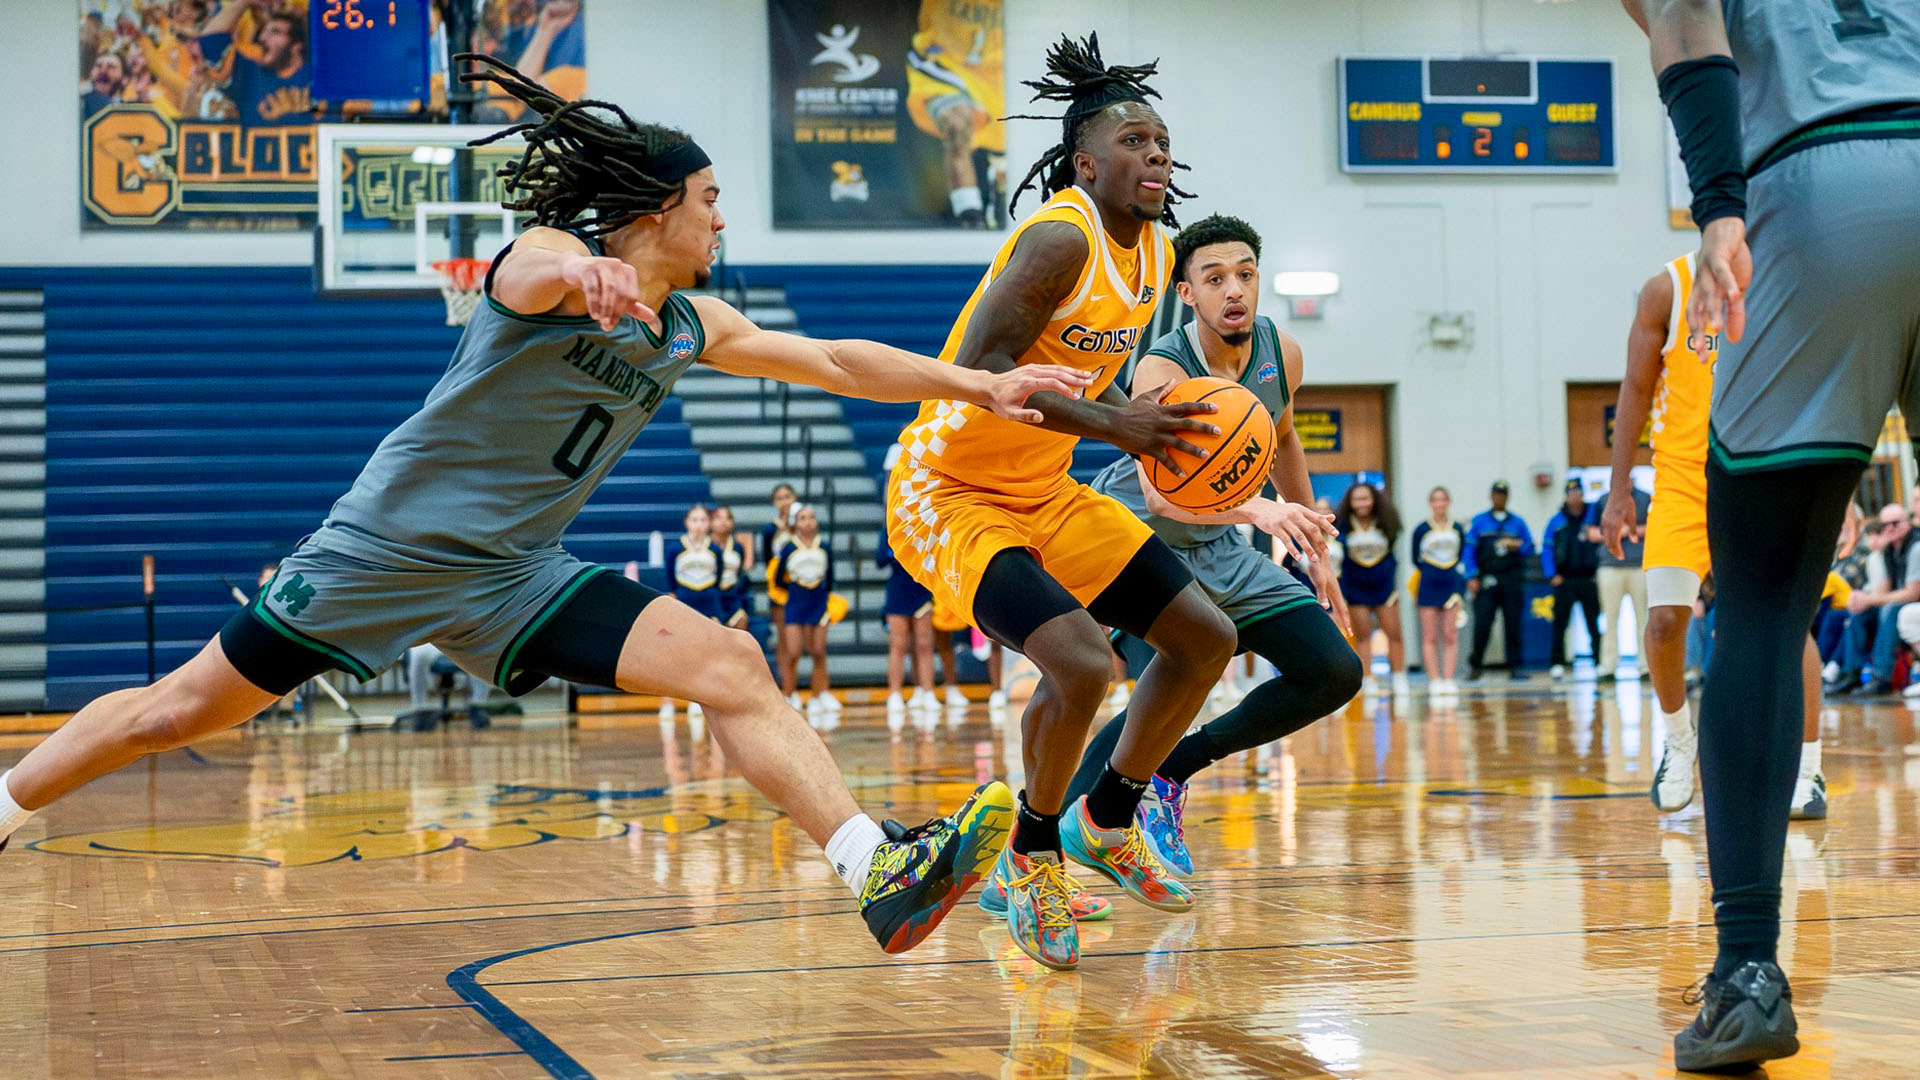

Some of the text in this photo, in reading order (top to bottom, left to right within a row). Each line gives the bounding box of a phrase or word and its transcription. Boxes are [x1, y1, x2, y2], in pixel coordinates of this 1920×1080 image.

[184, 129, 317, 178] BLOC
[1474, 127, 1492, 156] 2
[562, 335, 665, 413] MANHATTA
[552, 403, 614, 481] 0
[1209, 436, 1262, 495] NCAA
